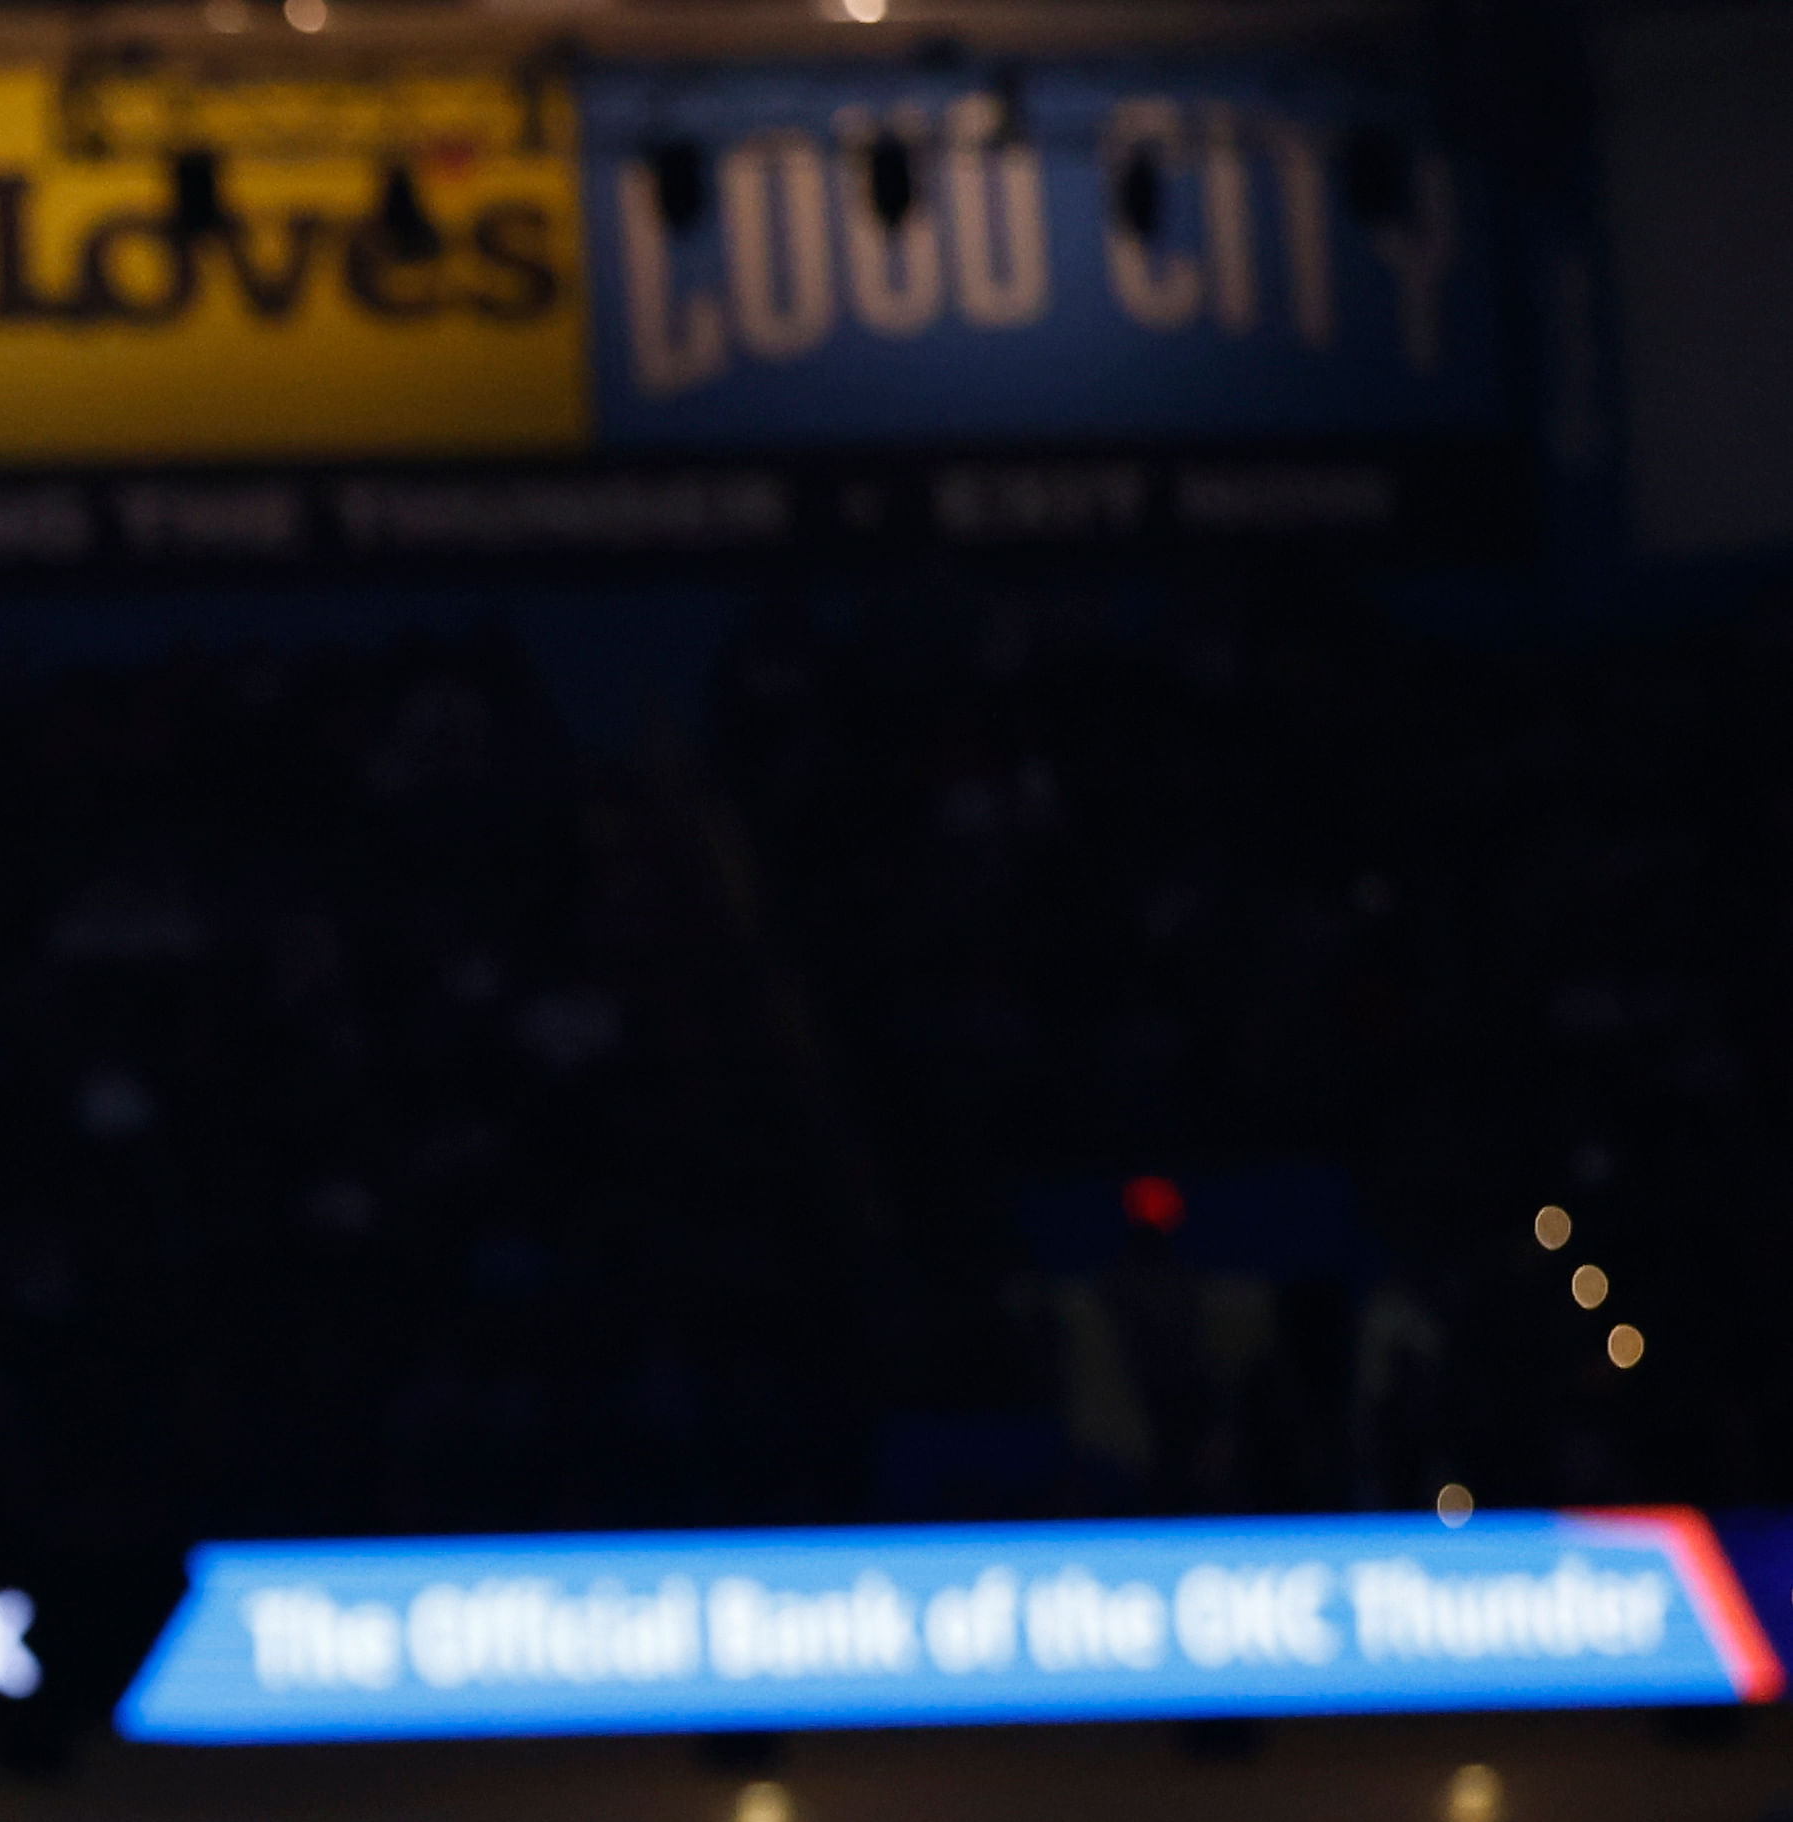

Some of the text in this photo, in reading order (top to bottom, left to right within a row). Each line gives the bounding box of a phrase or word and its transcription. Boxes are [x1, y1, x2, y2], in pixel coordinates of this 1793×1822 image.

[248, 1552, 1668, 1692] The Official Bank of the OKC Thunder
